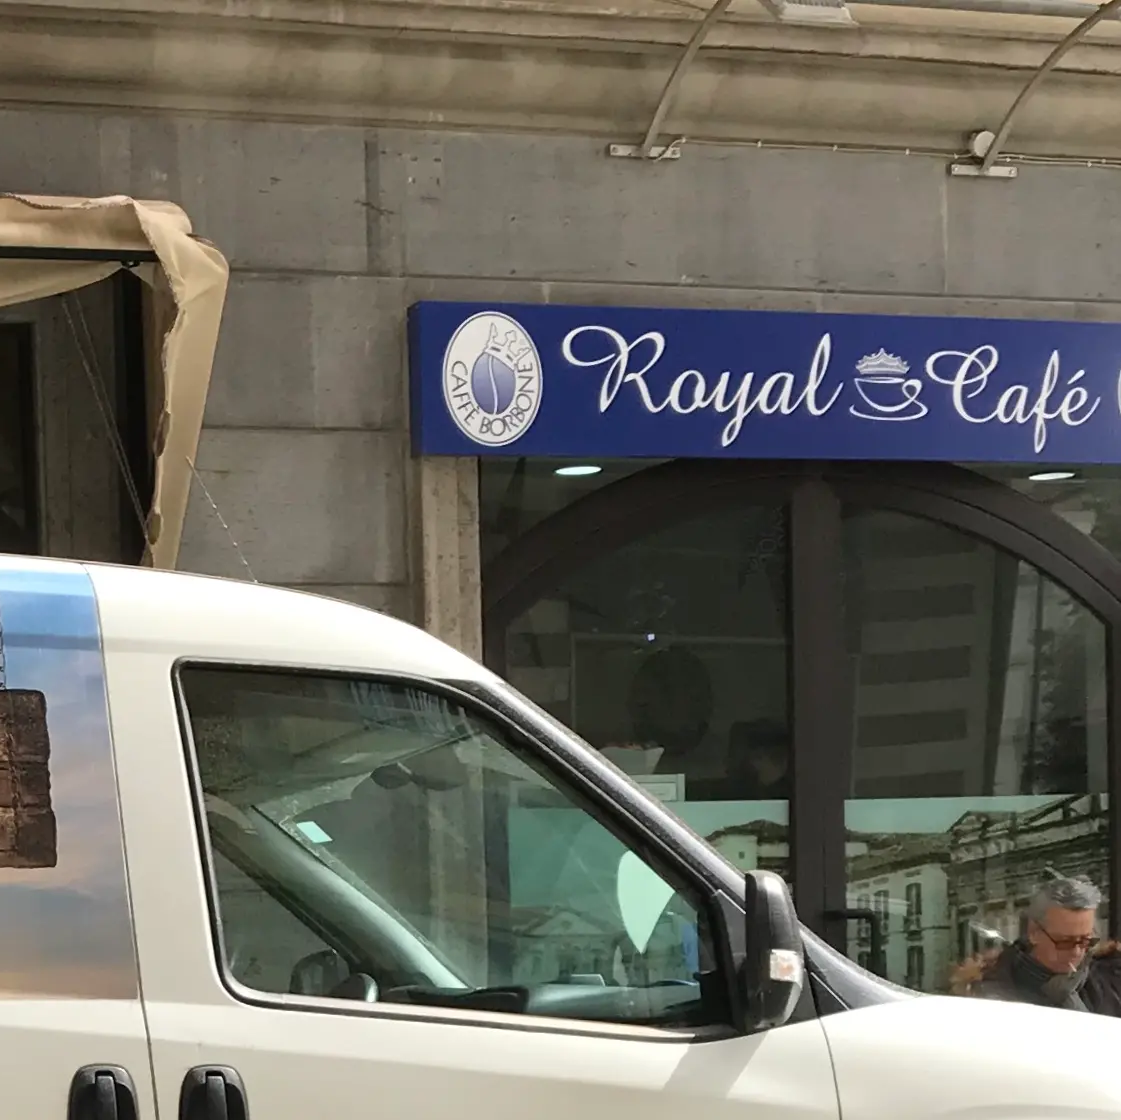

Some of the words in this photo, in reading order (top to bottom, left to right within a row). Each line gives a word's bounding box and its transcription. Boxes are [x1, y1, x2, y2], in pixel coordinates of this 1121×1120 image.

[479, 362, 535, 437] BORBONE
[562, 325, 843, 447] Royal
[925, 345, 1101, 453] Café
